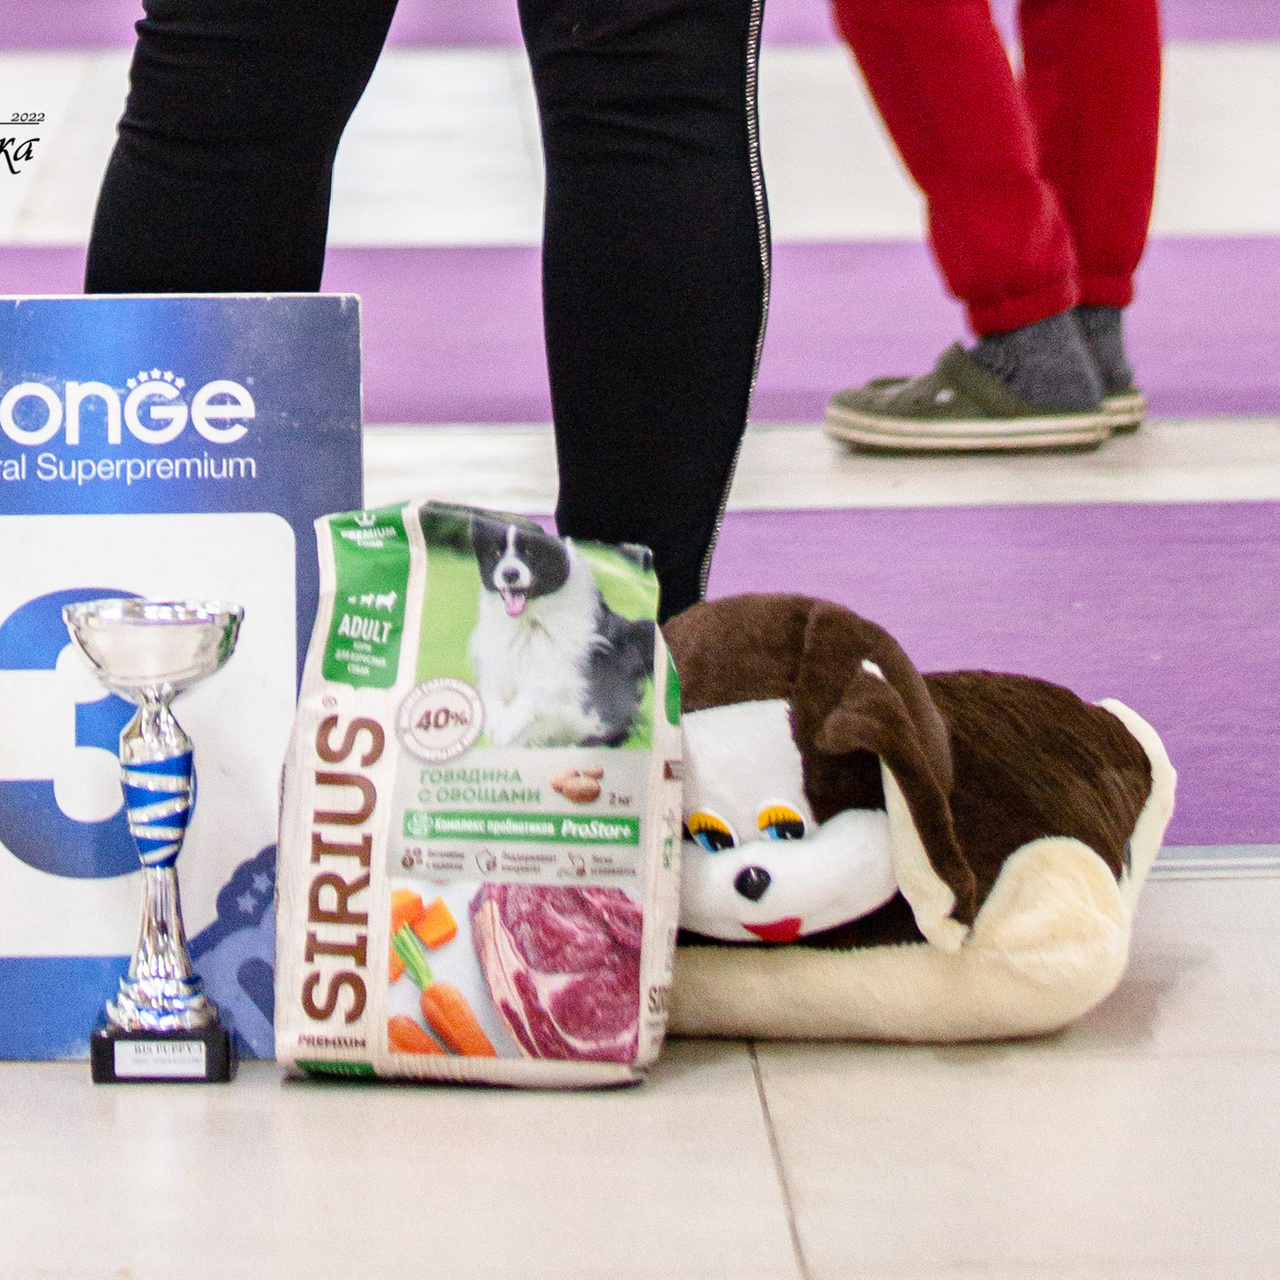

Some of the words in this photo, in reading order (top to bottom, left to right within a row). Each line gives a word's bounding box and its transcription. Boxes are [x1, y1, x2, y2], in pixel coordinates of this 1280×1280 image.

[36, 450, 257, 486] Superpremium
[337, 613, 393, 645] ADULT
[415, 706, 469, 732] 40%
[420, 768, 522, 784] ГОВЯДИНА
[417, 789, 431, 803] С
[435, 786, 541, 803] ОВОЩАМИ
[608, 792, 617, 806] 2
[301, 713, 385, 1025] SIRIUS
[298, 1033, 366, 1048] PREMIUM
